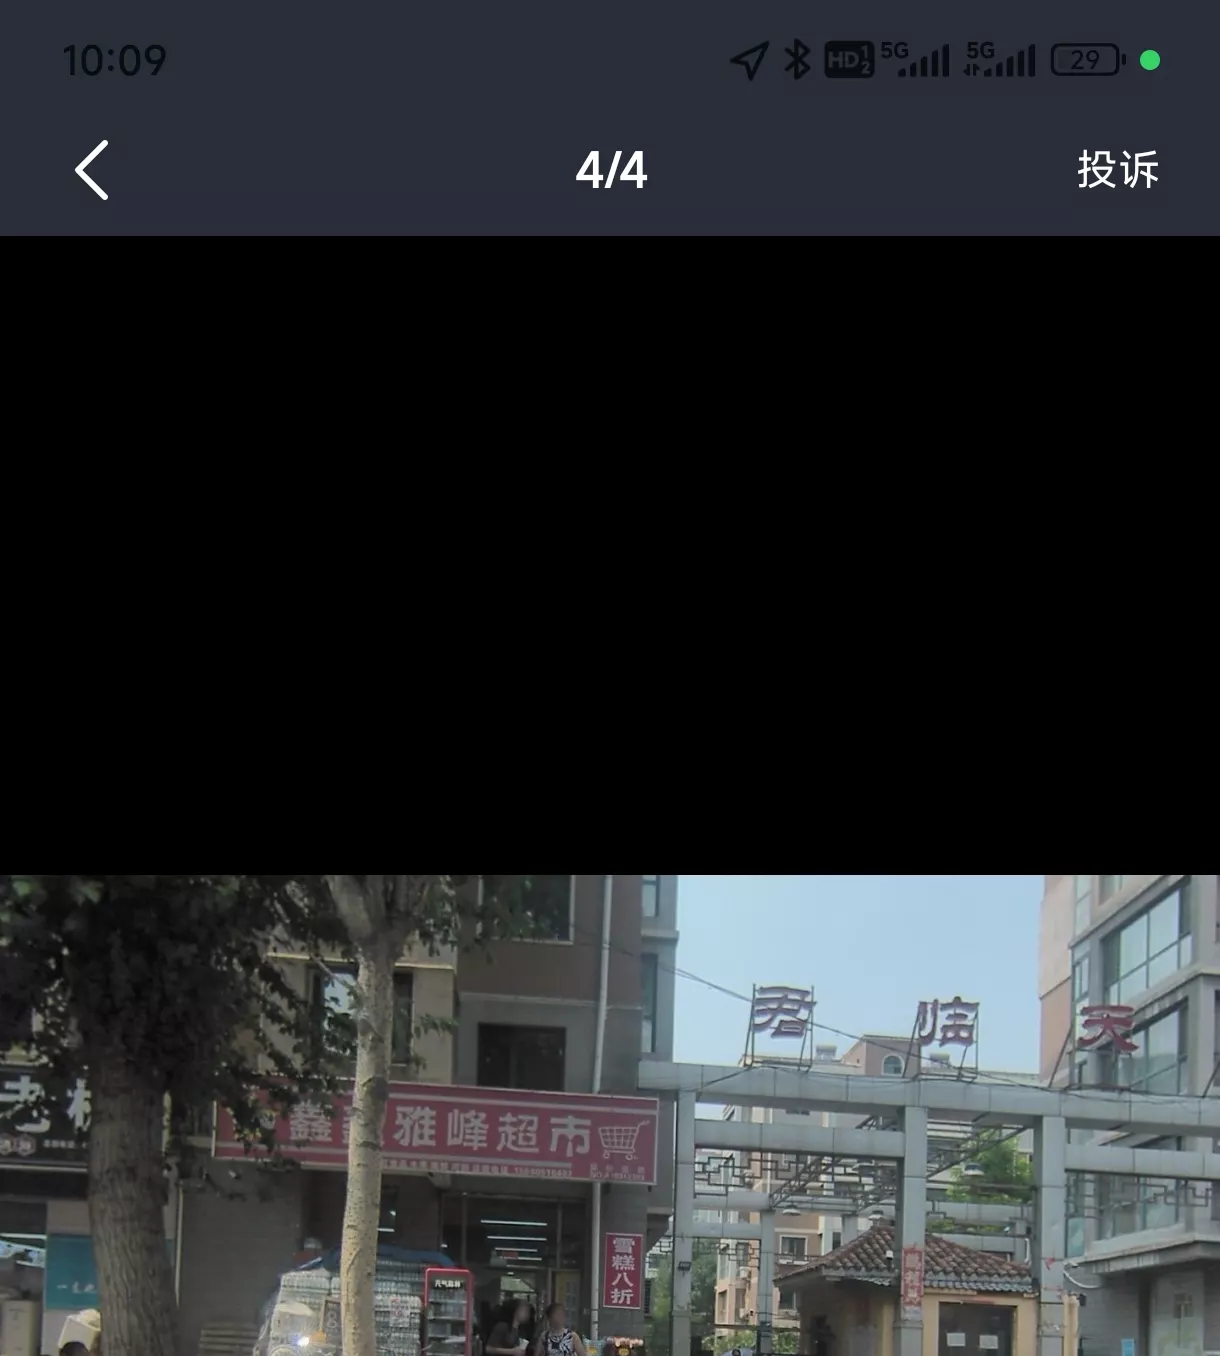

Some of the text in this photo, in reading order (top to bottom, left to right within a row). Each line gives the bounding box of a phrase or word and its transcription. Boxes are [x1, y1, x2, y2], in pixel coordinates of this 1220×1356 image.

[64, 45, 166, 77] 10:09
[881, 42, 909, 59] 5G
[966, 42, 995, 59] 5G
[1070, 50, 1100, 70] 29
[576, 151, 648, 189] 4/4
[1077, 149, 1159, 189] 投诉
[611, 1237, 636, 1305] 雪糕八折
